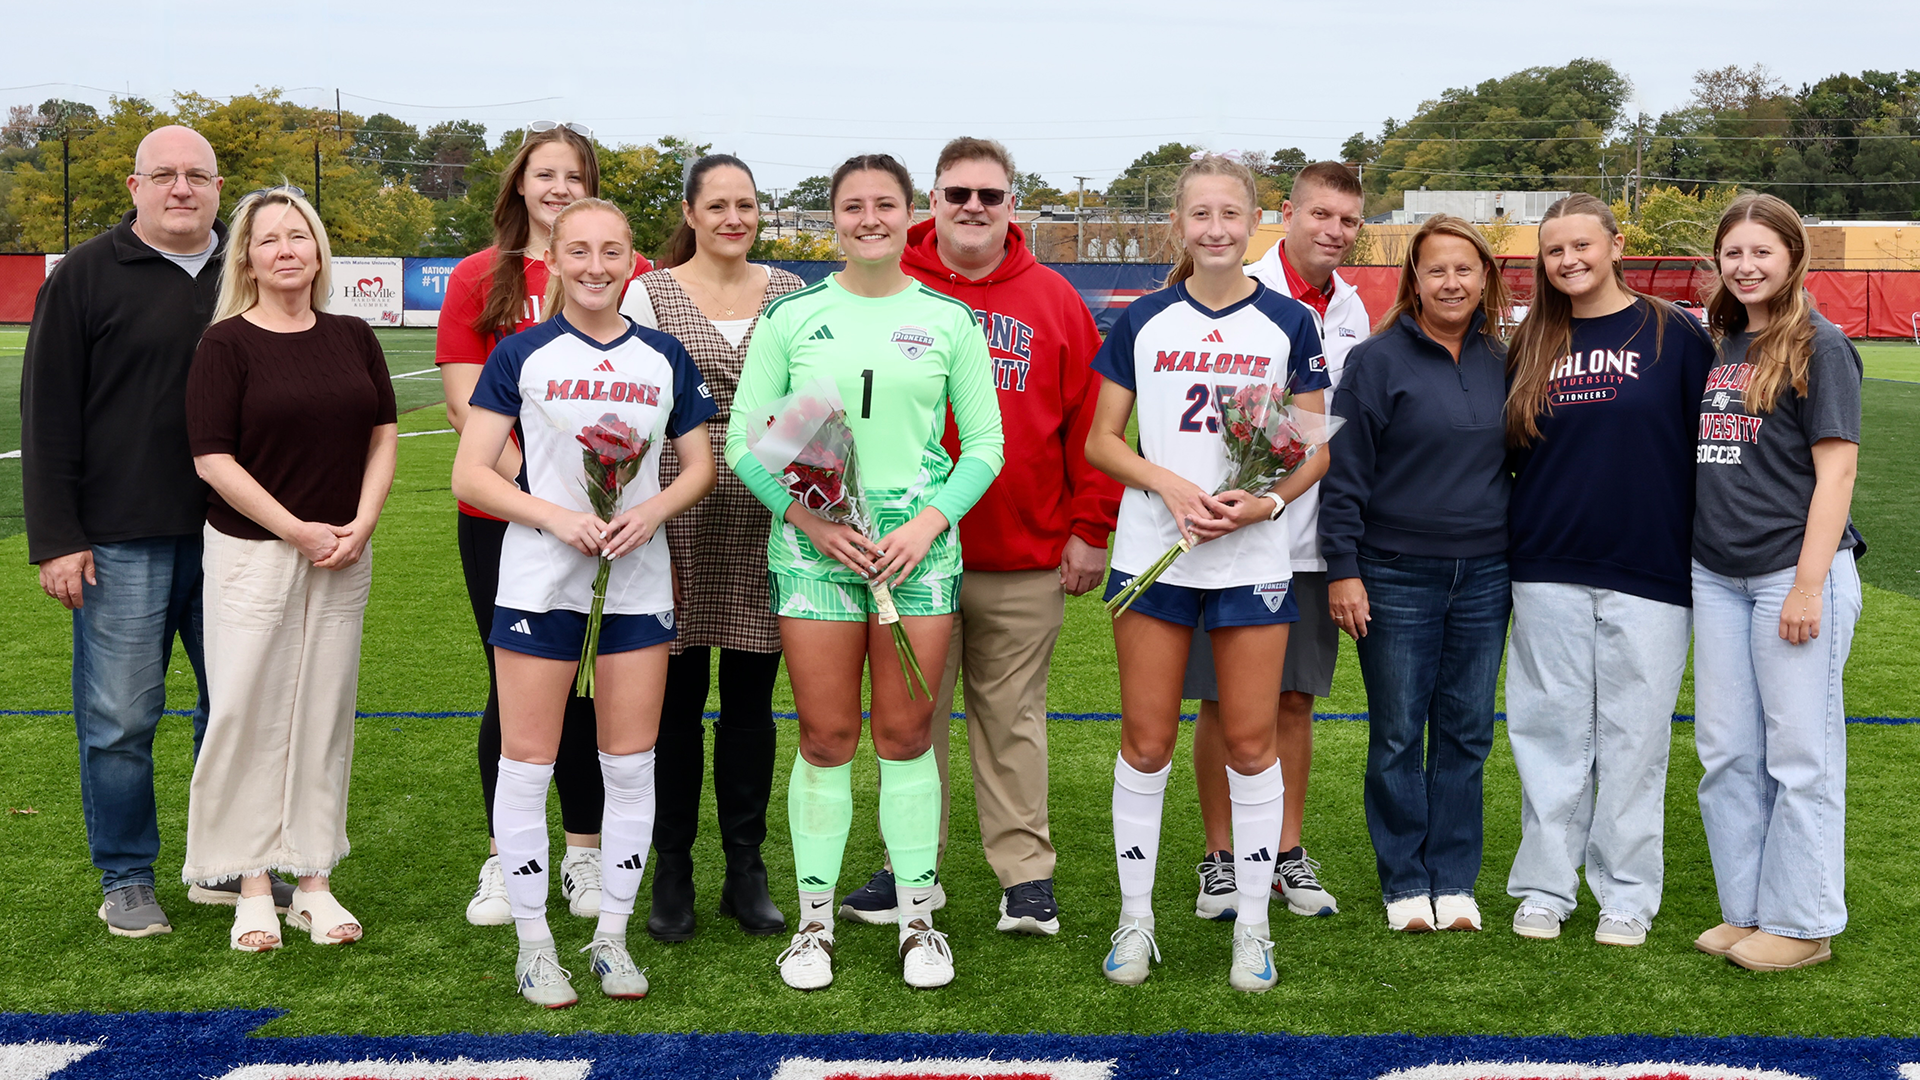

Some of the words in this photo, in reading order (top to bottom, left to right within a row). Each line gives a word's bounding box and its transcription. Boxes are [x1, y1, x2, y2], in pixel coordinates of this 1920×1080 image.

[343, 285, 396, 298] Hartville
[1154, 351, 1271, 378] MALONE
[545, 380, 660, 407] MALONE
[860, 369, 873, 419] 1
[1559, 390, 1607, 402] PIONEERS
